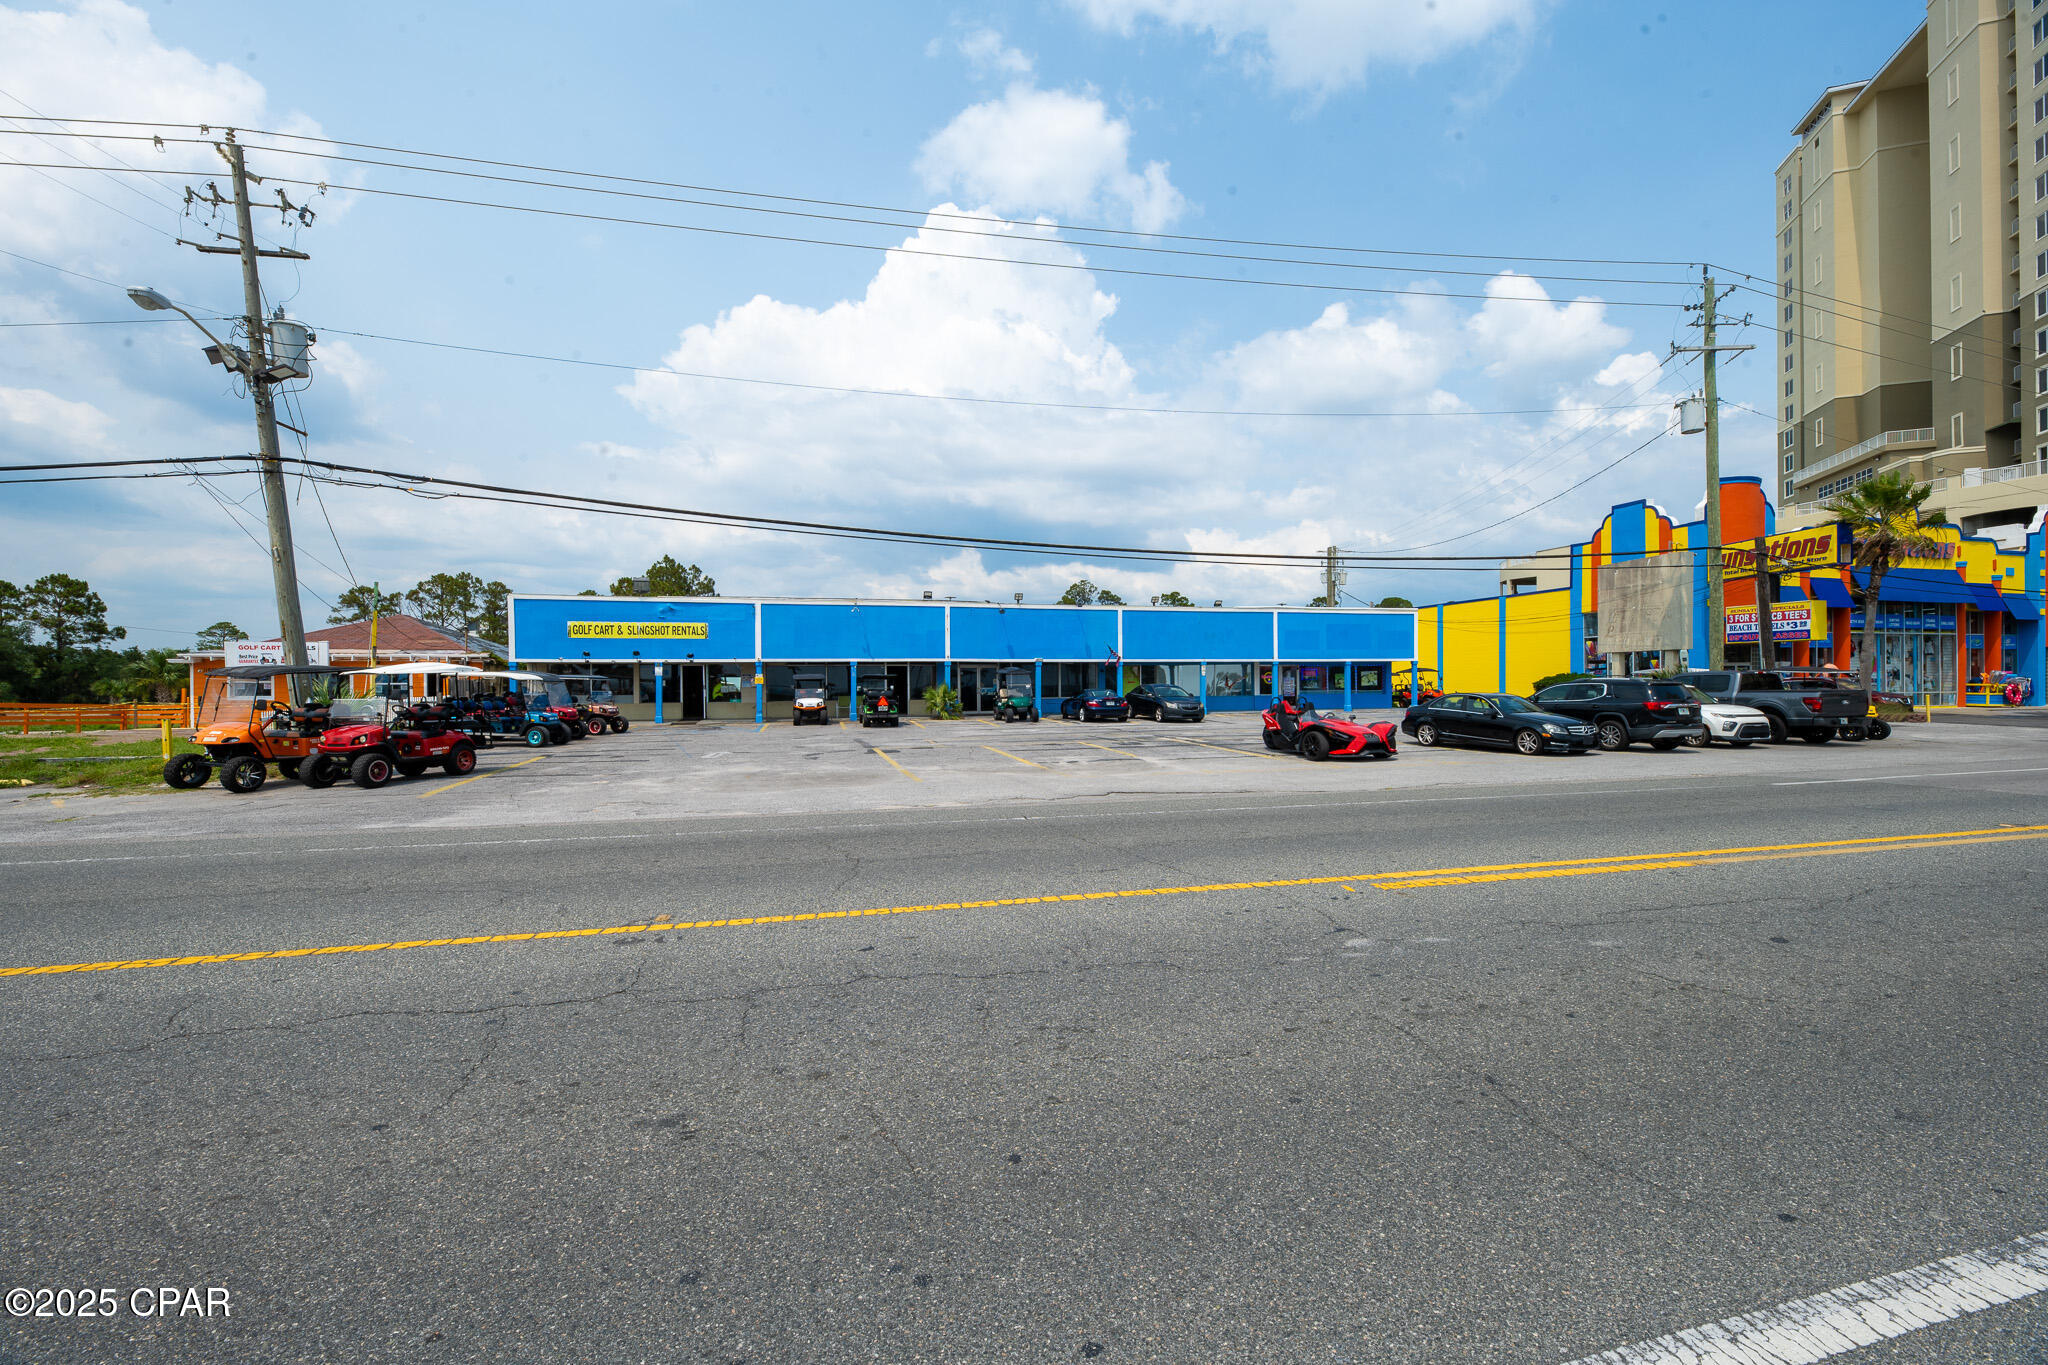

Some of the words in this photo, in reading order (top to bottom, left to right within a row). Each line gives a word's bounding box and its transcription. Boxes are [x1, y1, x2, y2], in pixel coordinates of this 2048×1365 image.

[1720, 534, 1832, 570] unstions
[1728, 614, 1734, 623] 3
[1734, 613, 1750, 623] FOR
[1771, 611, 1783, 620] CB
[1784, 609, 1808, 619] TEE'S
[572, 624, 592, 635] GOLF
[594, 624, 615, 635] CART
[616, 625, 624, 635] &
[627, 625, 670, 636] SLINGSHOT
[671, 626, 705, 636] RENTALS
[1729, 624, 1753, 632] BEACH
[1754, 621, 1785, 630] TELS
